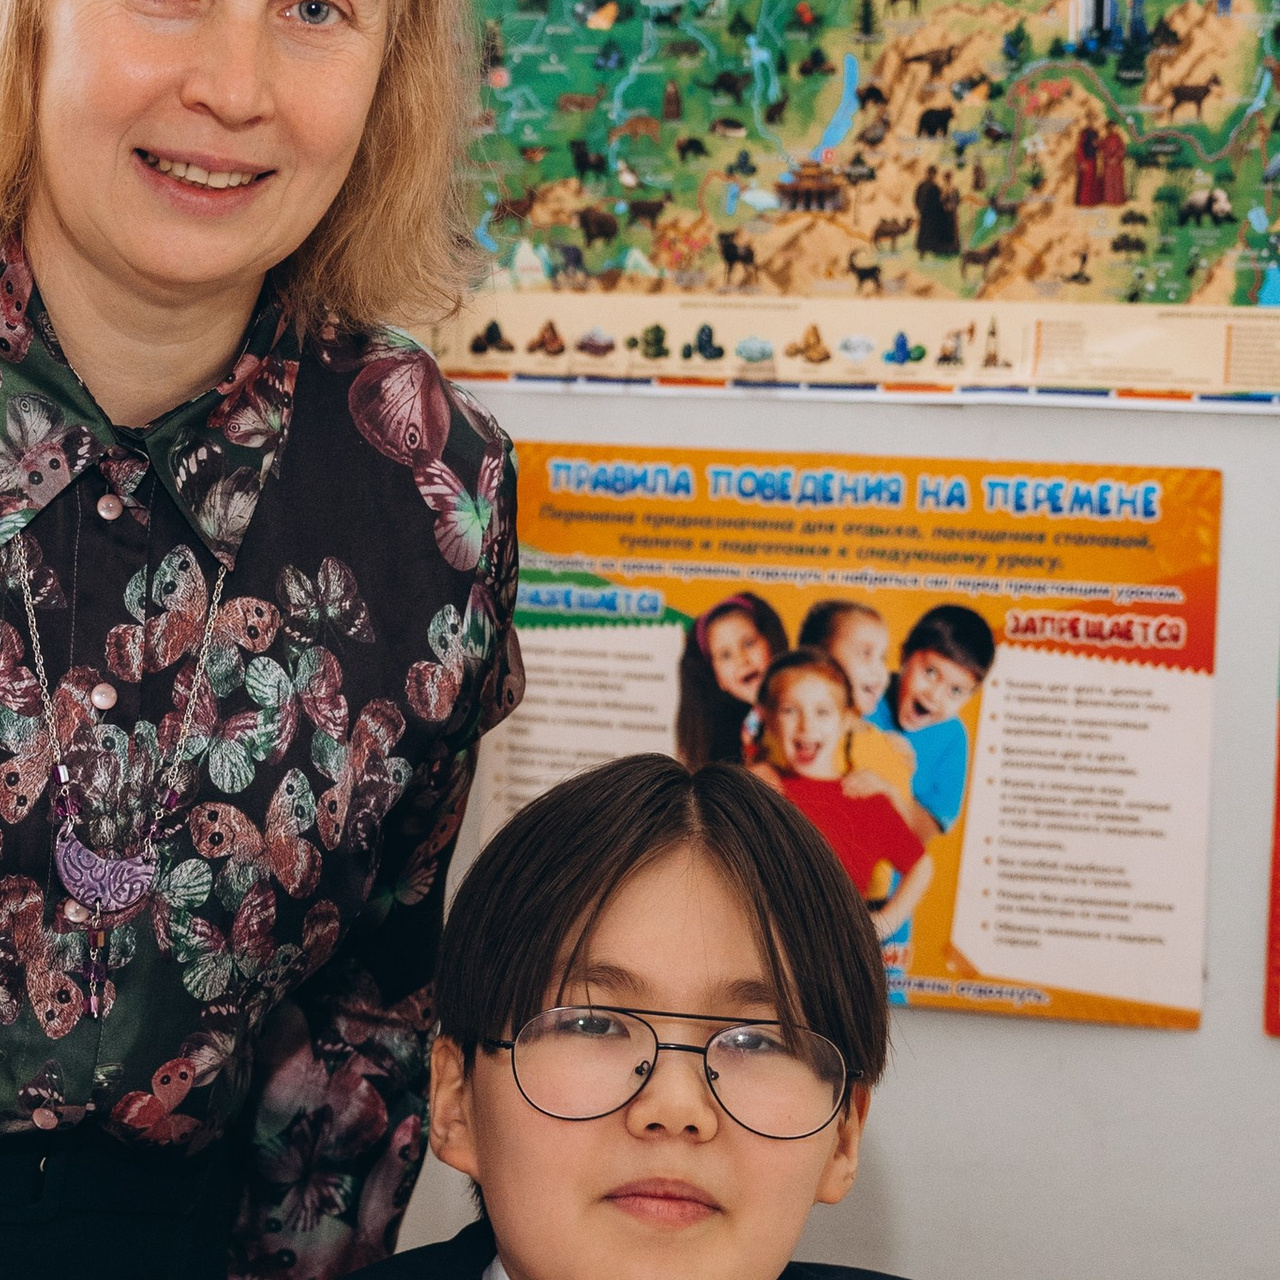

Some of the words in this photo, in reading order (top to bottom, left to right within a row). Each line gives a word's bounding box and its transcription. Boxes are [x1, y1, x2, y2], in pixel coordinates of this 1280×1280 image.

[548, 461, 693, 498] ПРАВИЛА
[709, 466, 902, 506] ПОВЕДЕНИЯ
[919, 476, 967, 509] НА
[986, 479, 1159, 519] ПЕРЕМЕНЕ
